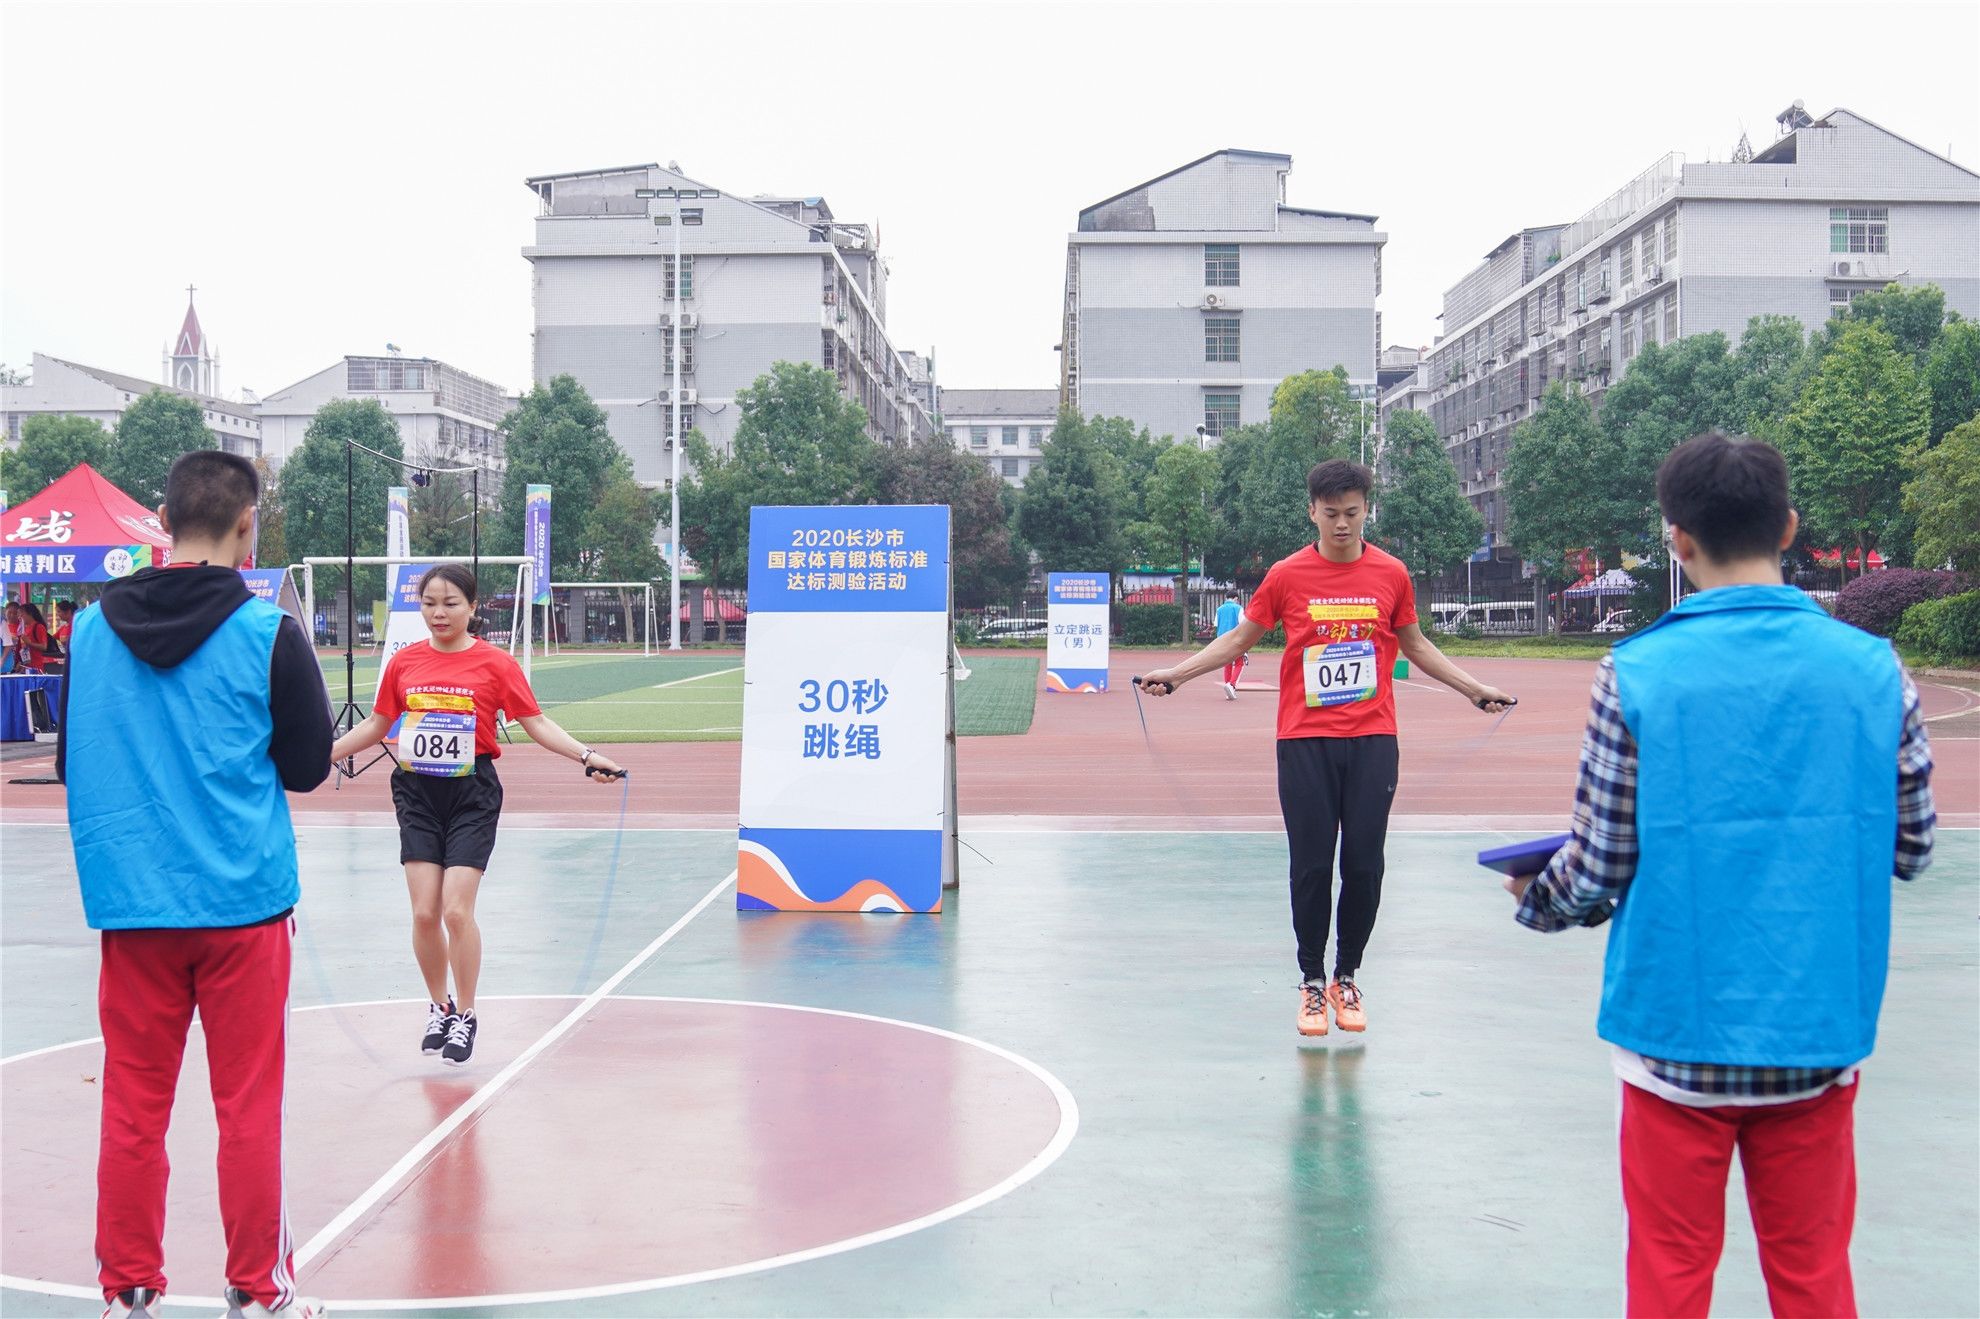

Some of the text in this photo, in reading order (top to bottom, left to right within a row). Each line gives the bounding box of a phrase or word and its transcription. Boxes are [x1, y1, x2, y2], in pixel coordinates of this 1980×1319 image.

[791, 529, 905, 547] 2020长沙市
[768, 551, 928, 569] 国家体育锻炼标准
[787, 572, 907, 591] 达标测验活动
[1054, 624, 1102, 635] 立定跳远
[1319, 661, 1361, 688] 047
[798, 678, 889, 715] 30秒
[413, 733, 460, 759] 084
[802, 723, 881, 760] 跳绳
